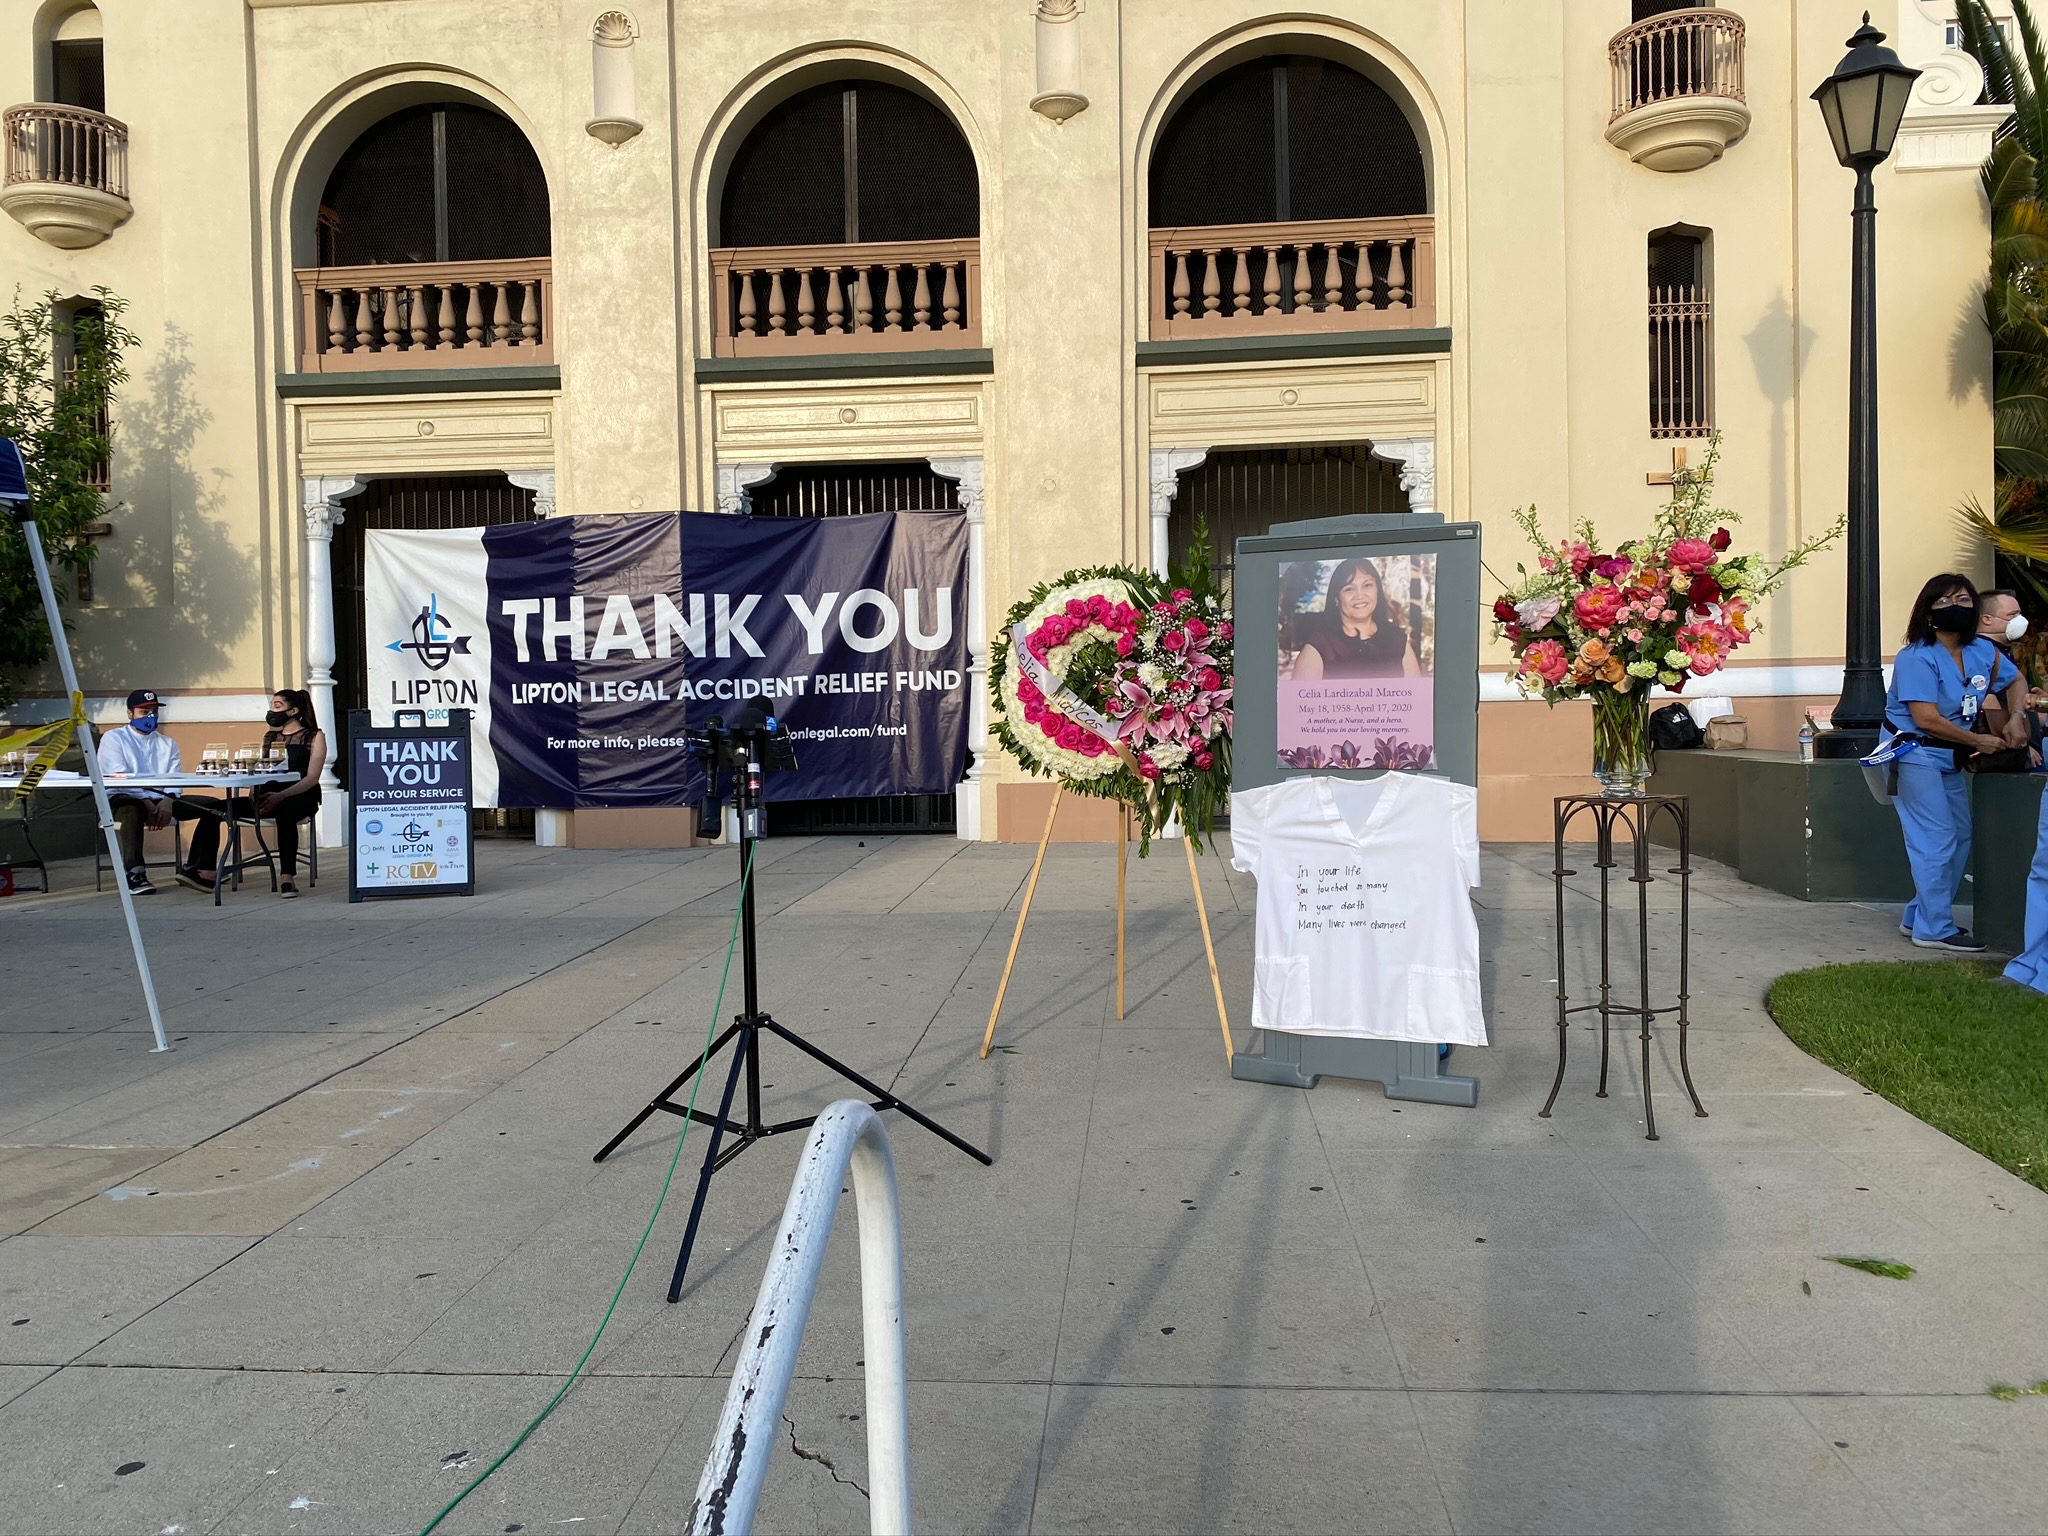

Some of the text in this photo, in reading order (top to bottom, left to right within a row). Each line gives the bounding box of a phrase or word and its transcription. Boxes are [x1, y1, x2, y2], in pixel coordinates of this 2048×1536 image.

[502, 587, 952, 662] THANK YOU
[391, 679, 478, 705] LIPTON
[512, 670, 962, 704] LIPTON LEGAL ACCIDENT RELIEF FUND
[1298, 688, 1412, 699] Celia Lardizabal Marcos
[427, 708, 449, 720] GRO
[1298, 703, 1412, 714] May 18, 1958-April 17, 2020
[1313, 717, 1337, 725] mother,
[1345, 717, 1365, 725] Nurse,
[790, 724, 907, 741] onlegal.com/fund
[1360, 726, 1380, 734] loving
[547, 734, 685, 750] For more info, please
[363, 741, 458, 763] THANK
[381, 764, 440, 785] YOU
[362, 788, 464, 799] FOR YOUR SERVICE
[392, 844, 434, 854] LIPTON
[1297, 865, 1361, 882] In your life
[1296, 883, 1309, 896] You
[1317, 882, 1348, 895] touched
[1298, 900, 1365, 915] In your death
[1298, 919, 1323, 933] Many
[1328, 919, 1346, 929] lives
[1350, 920, 1367, 928] were
